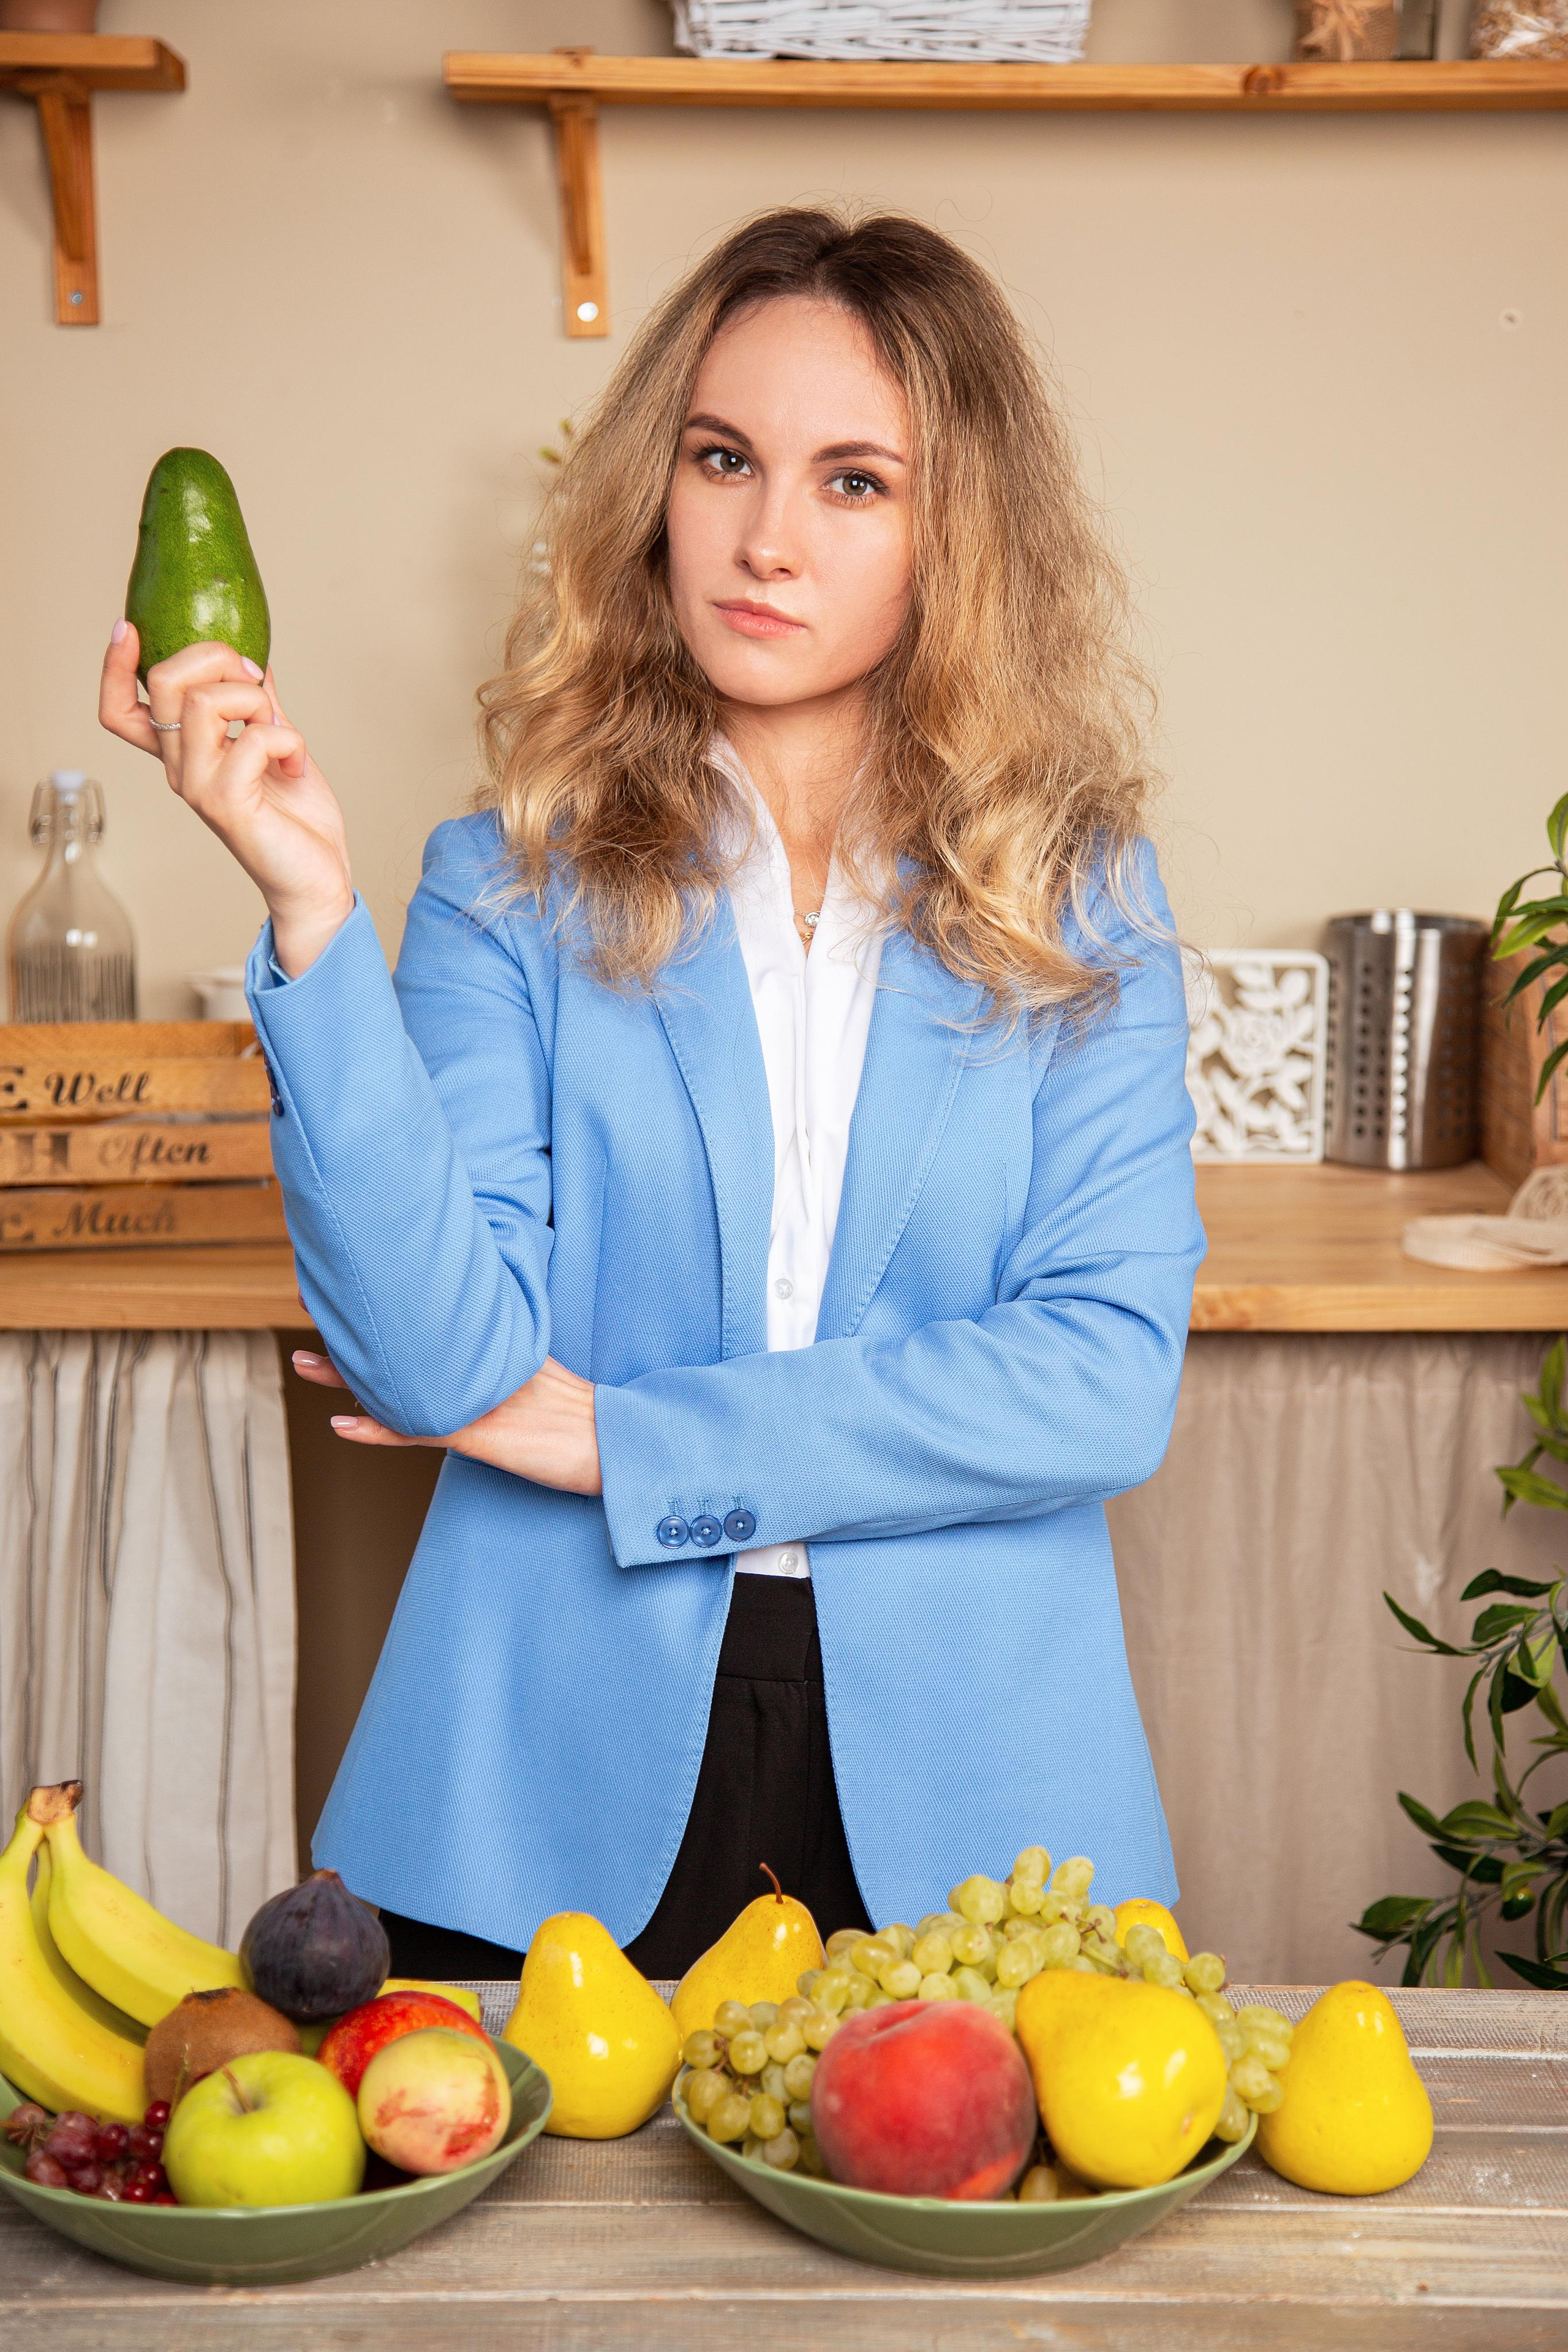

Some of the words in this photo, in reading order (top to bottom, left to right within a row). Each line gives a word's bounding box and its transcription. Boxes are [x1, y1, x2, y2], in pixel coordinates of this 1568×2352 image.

[44, 1071, 153, 1106] Well
[98, 1132, 209, 1177] Often
[51, 1199, 178, 1235] Much
